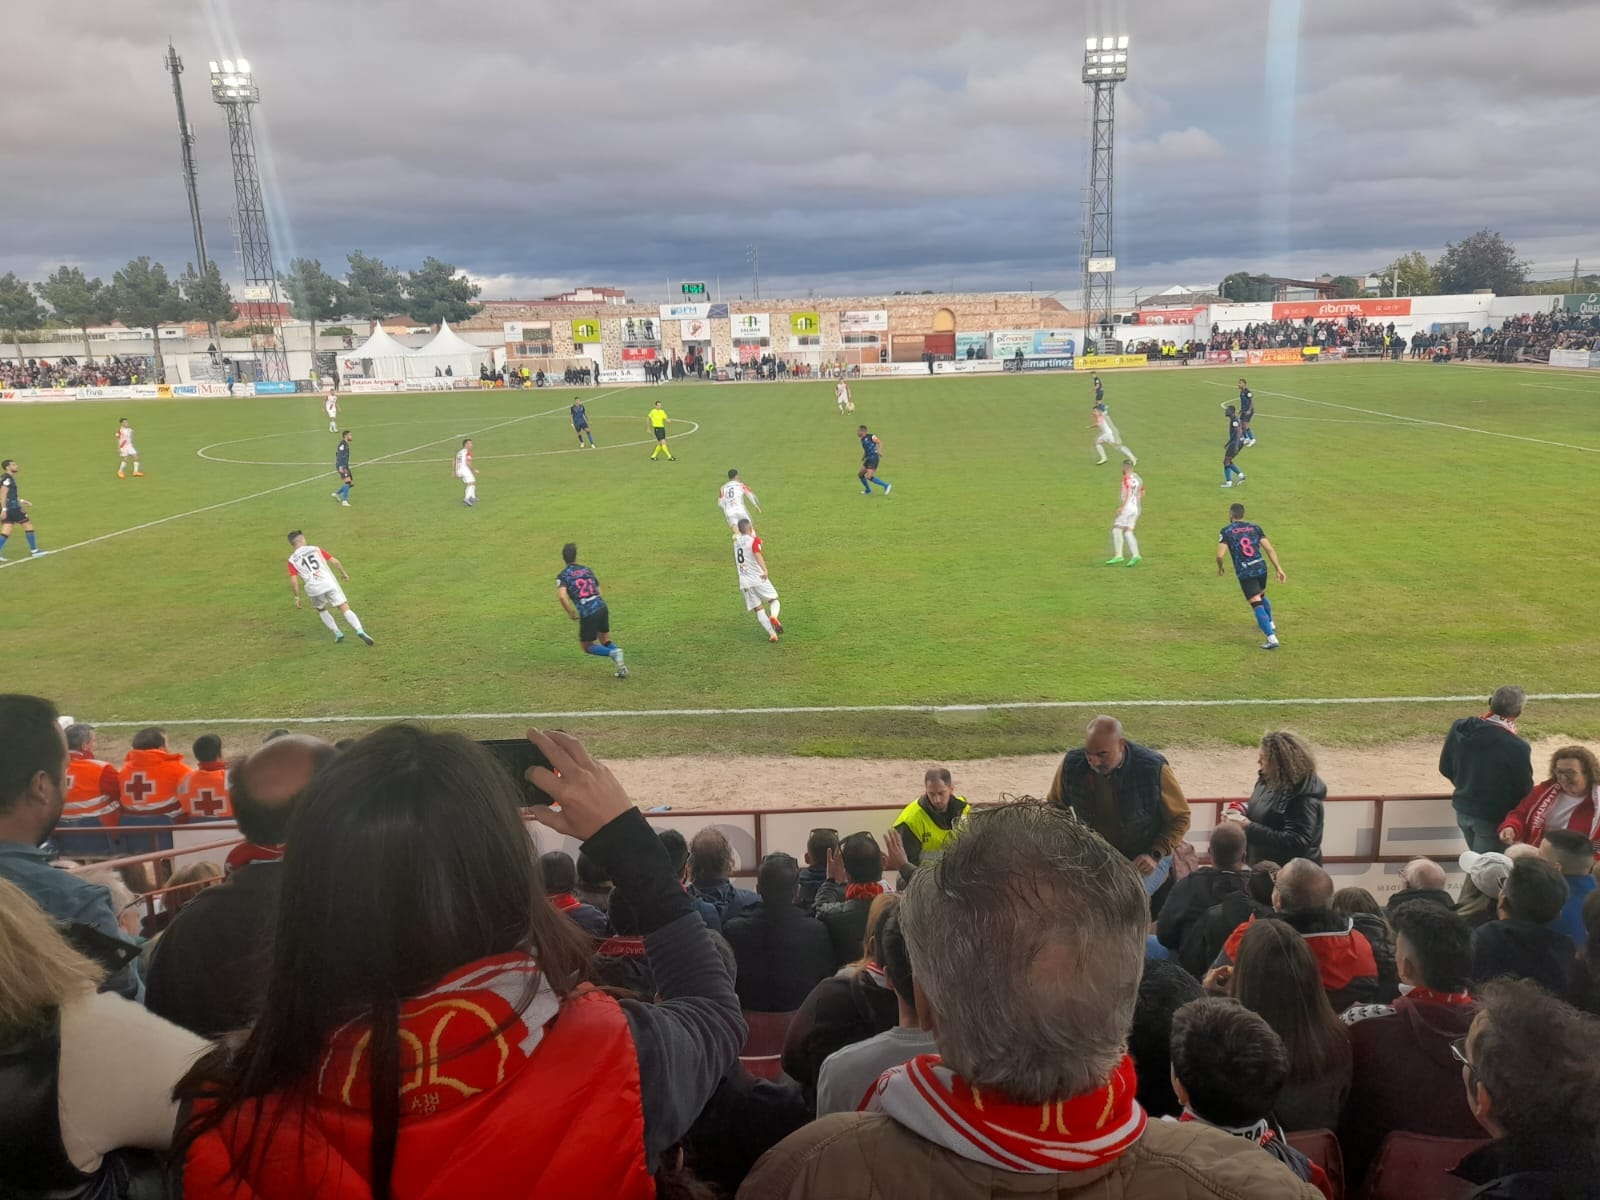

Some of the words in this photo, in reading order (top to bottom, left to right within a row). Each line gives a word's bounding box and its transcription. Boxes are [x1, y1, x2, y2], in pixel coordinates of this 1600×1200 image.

[729, 488, 735, 498] 6
[737, 548, 745, 563] 8
[1240, 537, 1255, 557] 8
[301, 554, 320, 573] 15
[576, 578, 595, 597] 21
